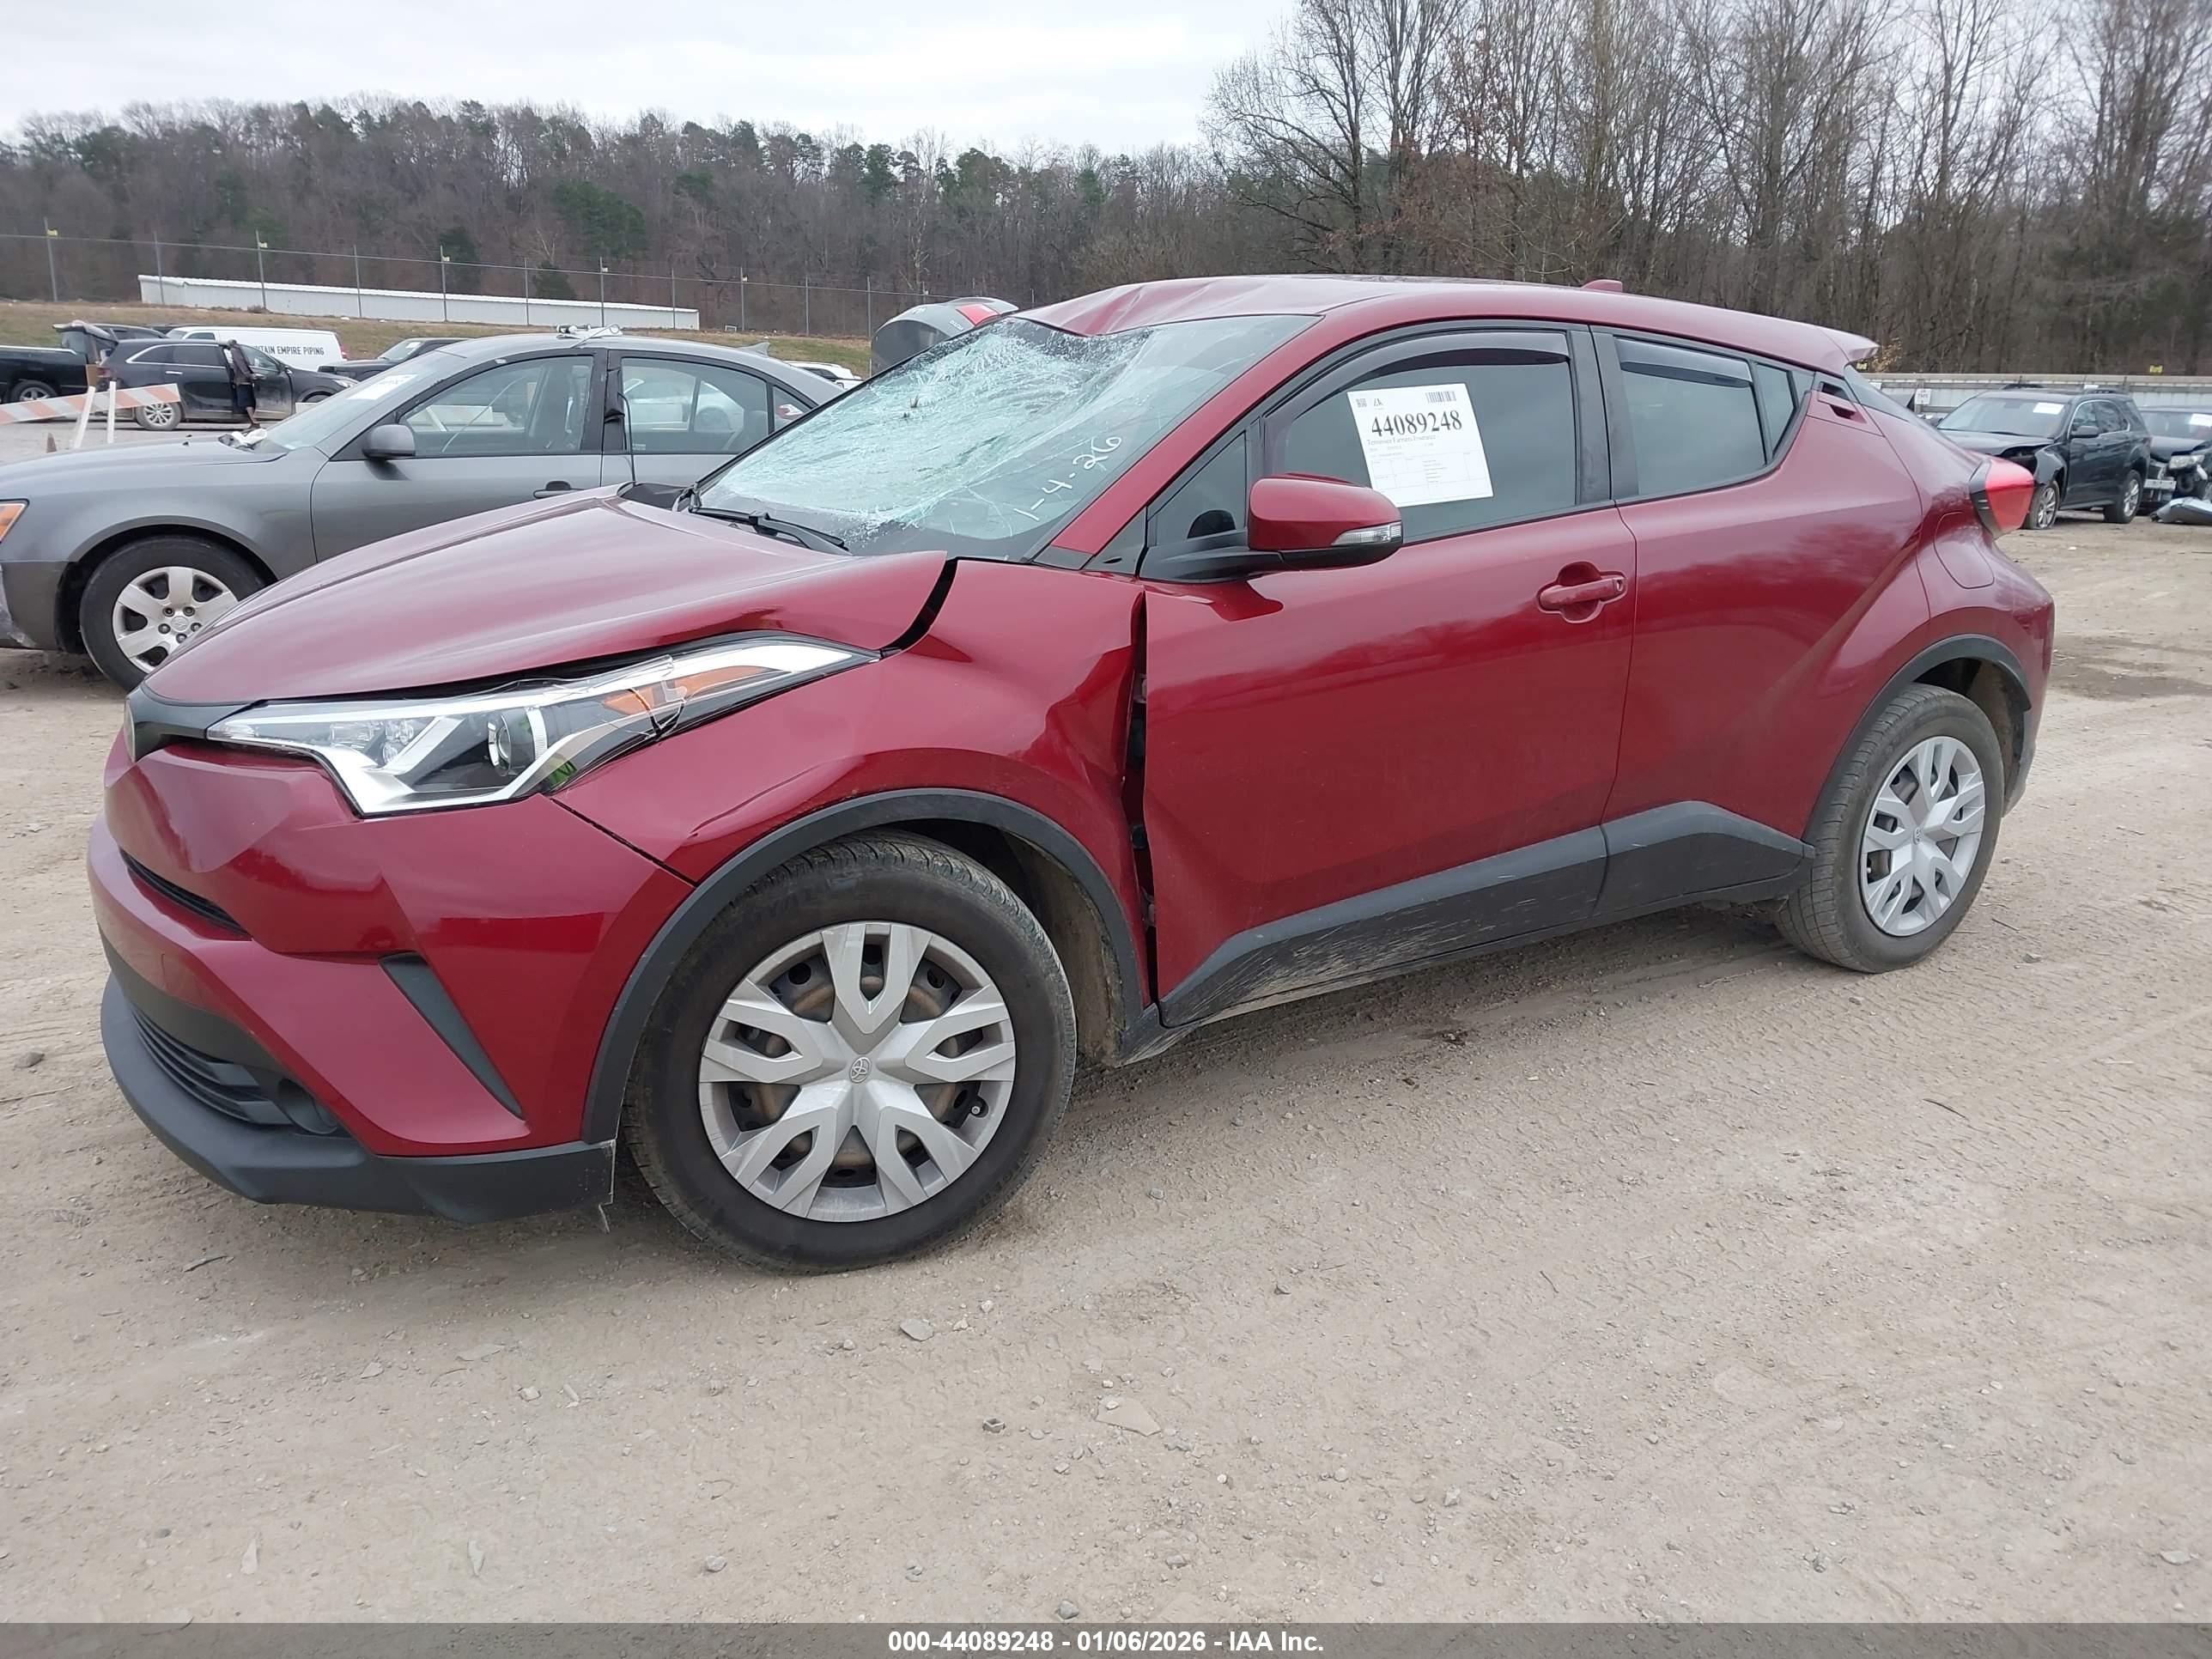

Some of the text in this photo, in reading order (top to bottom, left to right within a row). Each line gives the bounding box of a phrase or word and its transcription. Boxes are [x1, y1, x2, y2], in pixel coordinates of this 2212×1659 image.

[277, 346, 301, 356] EMPIRE
[303, 347, 325, 356] PIPING
[1371, 410, 1462, 437] 44089248
[1013, 436, 1122, 522] 1-4-26
